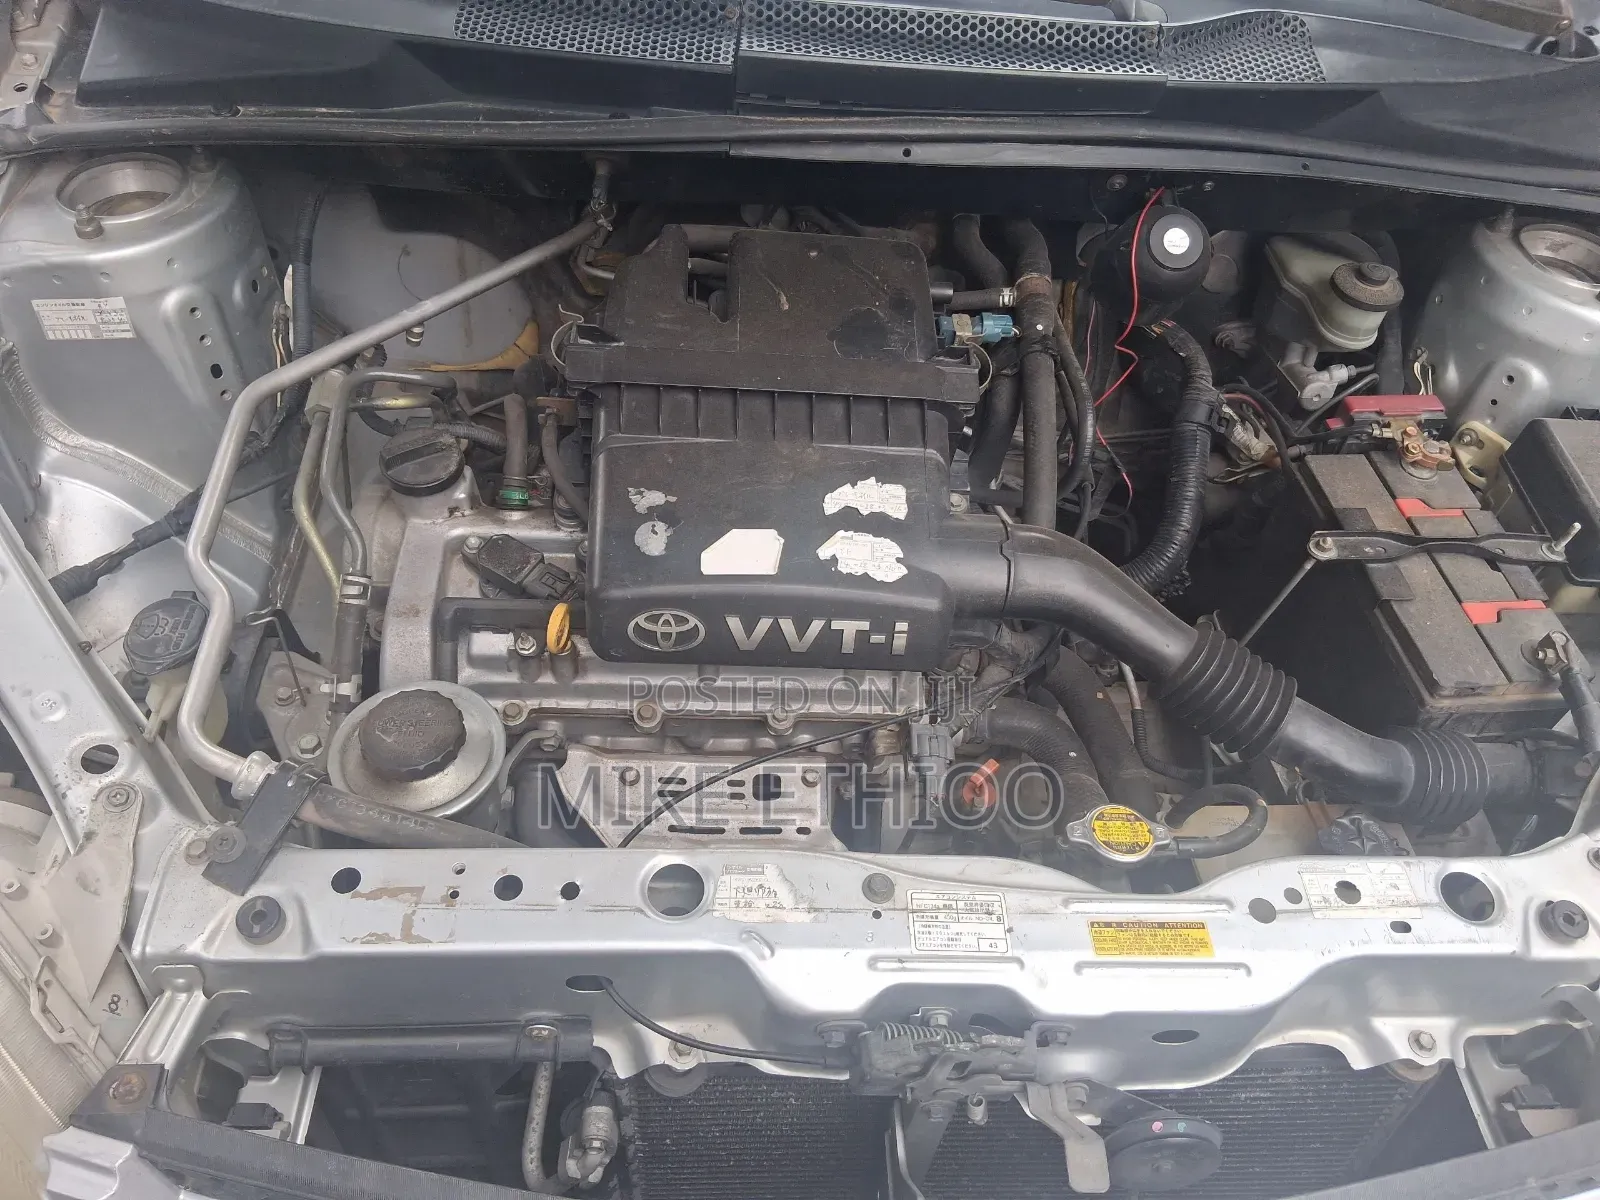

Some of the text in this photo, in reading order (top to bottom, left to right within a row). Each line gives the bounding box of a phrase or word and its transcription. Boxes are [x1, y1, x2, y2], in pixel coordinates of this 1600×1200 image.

[724, 614, 910, 656] VVT-i
[1121, 921, 1159, 929] CAUTION
[1163, 922, 1205, 930] ATTENTION
